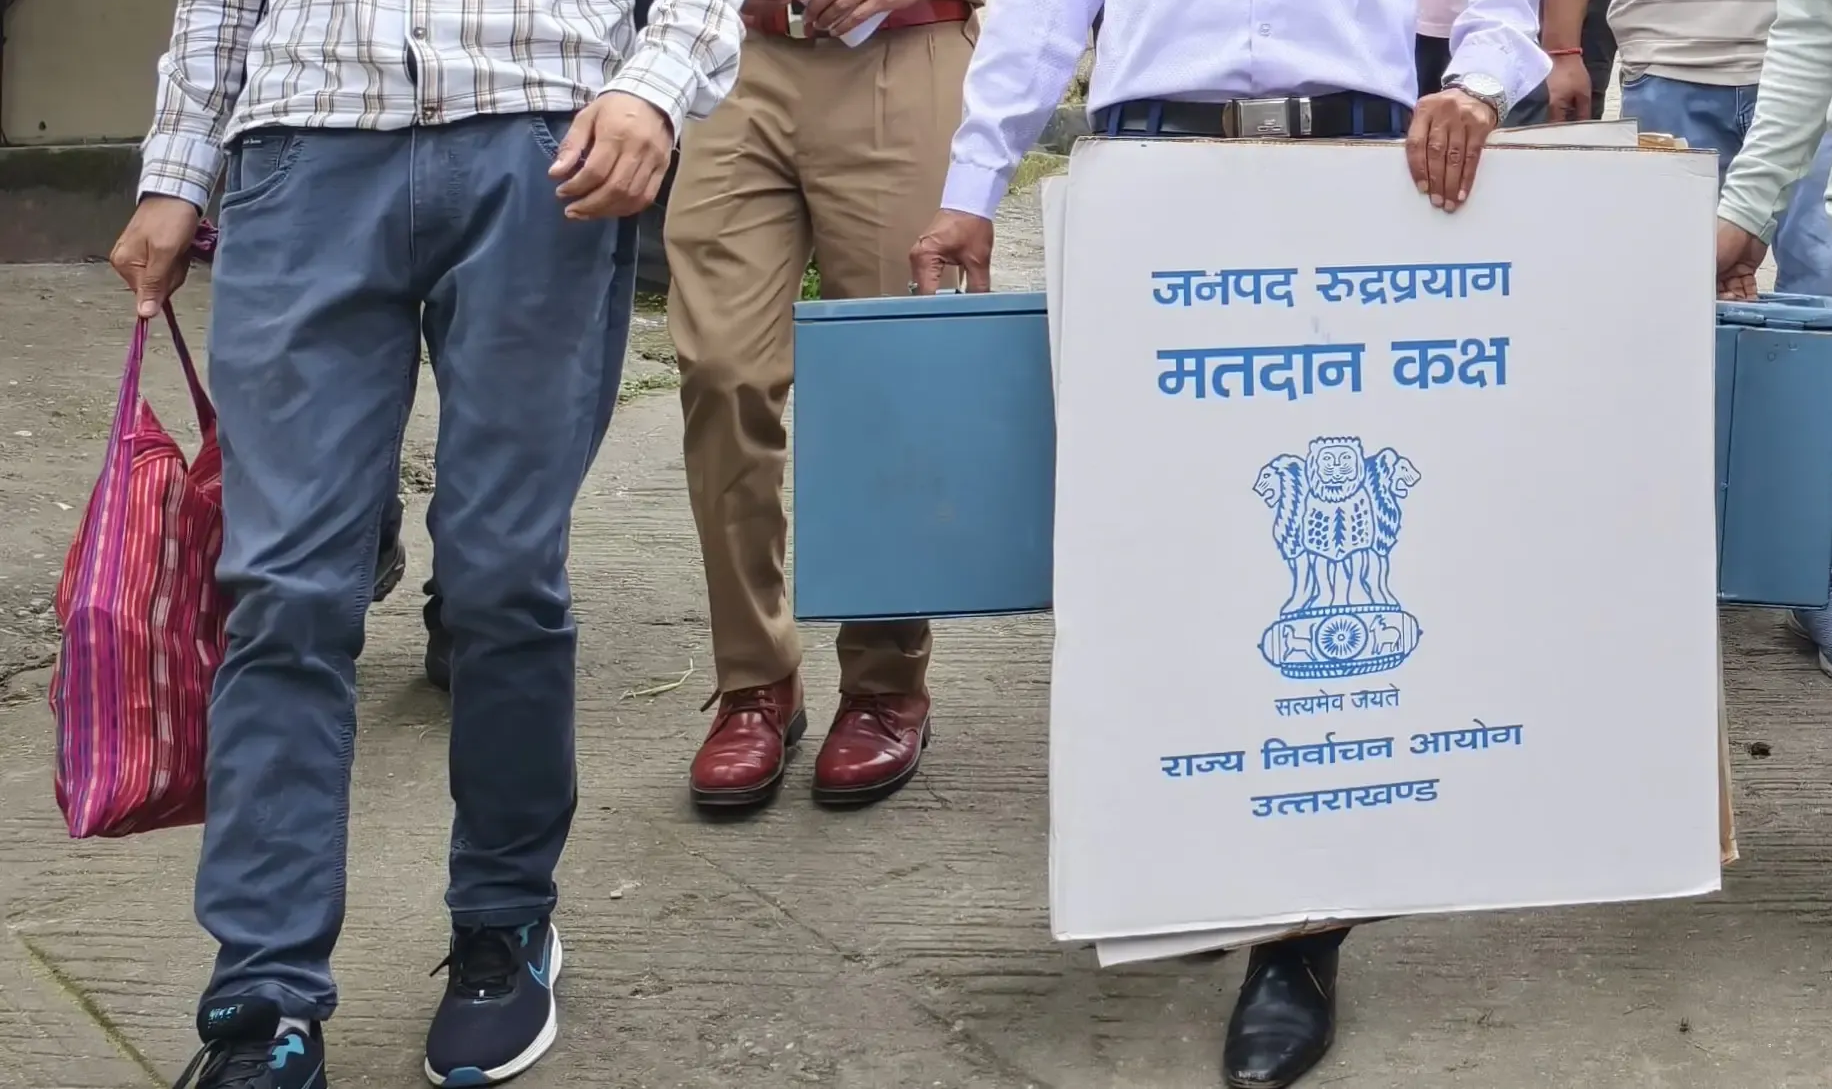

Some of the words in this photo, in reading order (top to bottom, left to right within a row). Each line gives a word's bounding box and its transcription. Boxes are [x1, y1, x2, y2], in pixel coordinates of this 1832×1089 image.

[1152, 267, 1298, 309] जनपद
[1315, 261, 1513, 308] रुद्रप्रयाग
[1156, 342, 1367, 402] मतदान
[1390, 336, 1511, 392] कक्ष
[1274, 689, 1344, 717] सत्यमेव
[1350, 684, 1401, 711] जयते
[1161, 751, 1246, 779] राज्य
[1262, 732, 1394, 770] निर्वाचन
[1411, 719, 1524, 757] आयोग
[1252, 779, 1438, 818] उत्तराखण्ड
